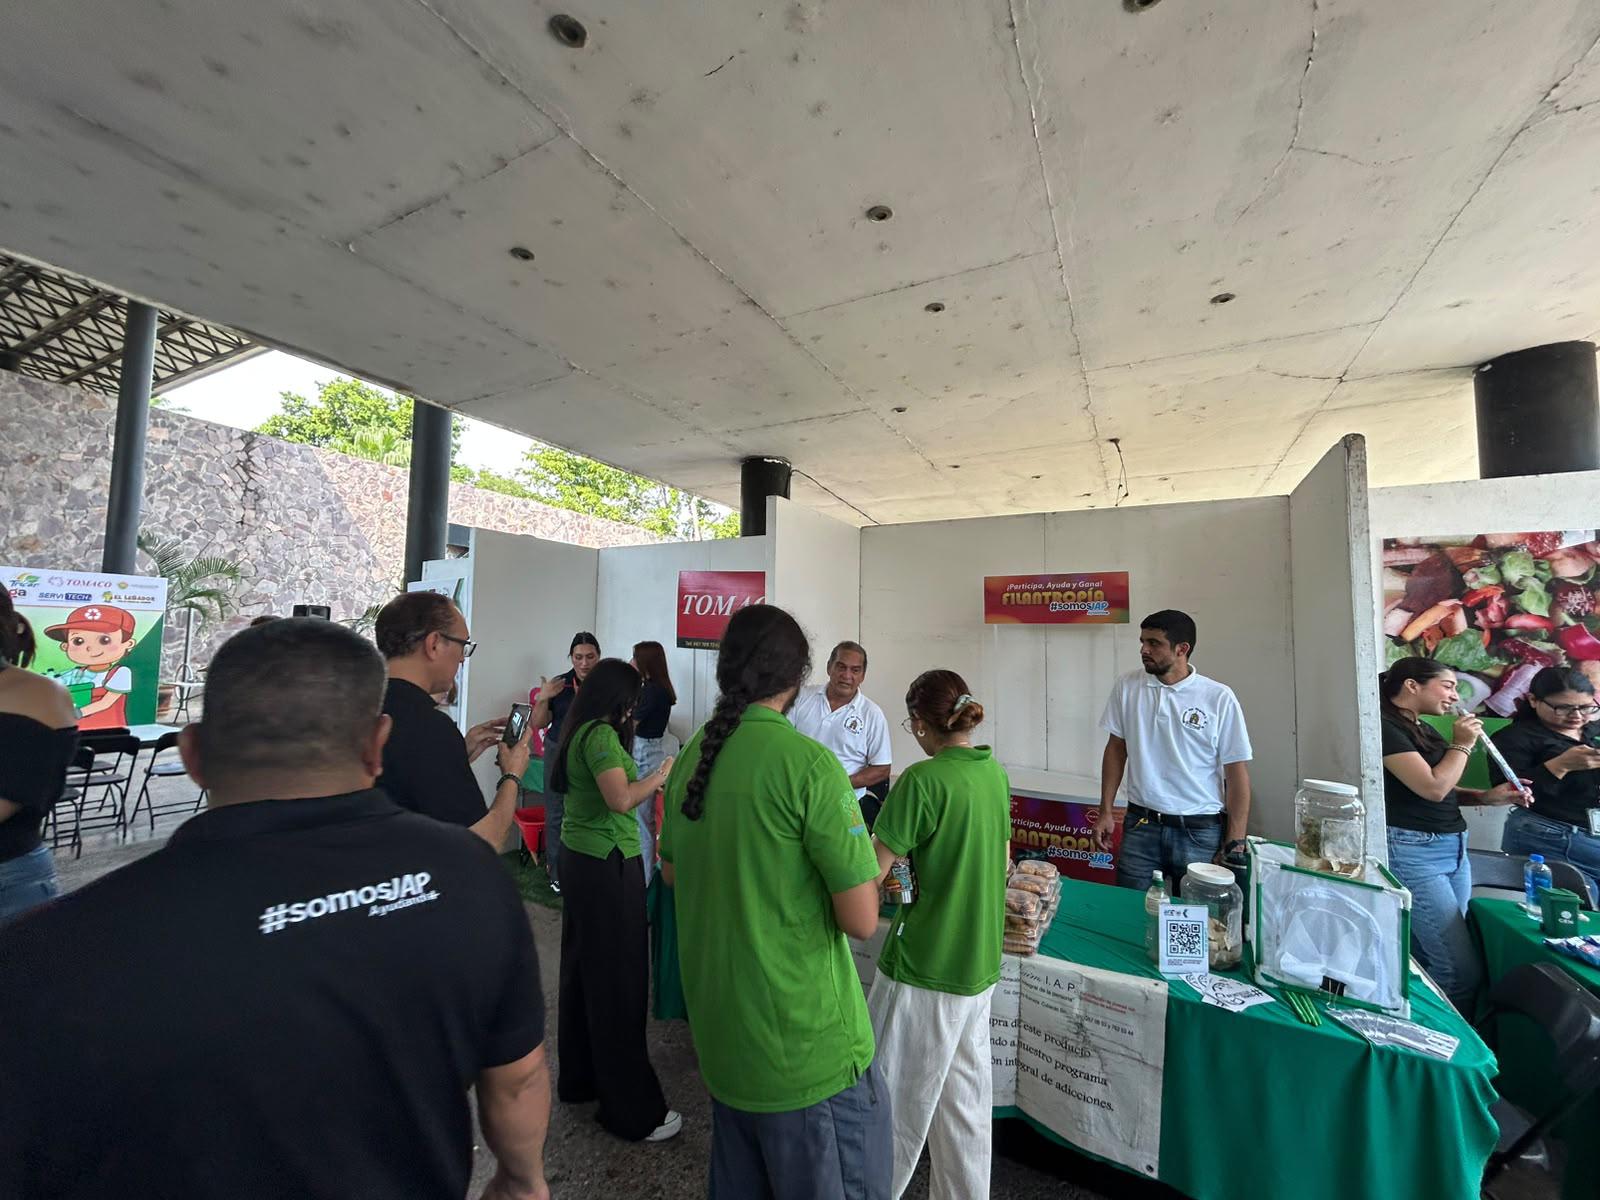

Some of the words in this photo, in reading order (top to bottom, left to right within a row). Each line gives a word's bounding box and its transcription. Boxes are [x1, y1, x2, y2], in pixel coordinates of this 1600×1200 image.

[66, 579, 113, 588] TOMACO
[1046, 580, 1071, 591] Ayuda
[1072, 581, 1078, 590] y
[1079, 580, 1103, 589] Gana!
[38, 591, 64, 600] SERVI
[1001, 587, 1105, 606] FILANTROPÍA
[1050, 601, 1108, 612] #somosJAP
[1044, 821, 1071, 834] Ayuda
[1073, 826, 1078, 835] y
[1047, 845, 1113, 864] #somosJAP
[258, 871, 432, 934] #somosJAP
[1023, 1022, 1041, 1037] este
[1044, 1033, 1092, 1058] producto
[1009, 1039, 1016, 1047] a
[1019, 1039, 1053, 1063] nuestro
[1054, 1059, 1108, 1086] programa
[1005, 1056, 1039, 1078] integral
[1041, 1072, 1053, 1086] de
[1055, 1083, 1114, 1111] adicciones.
